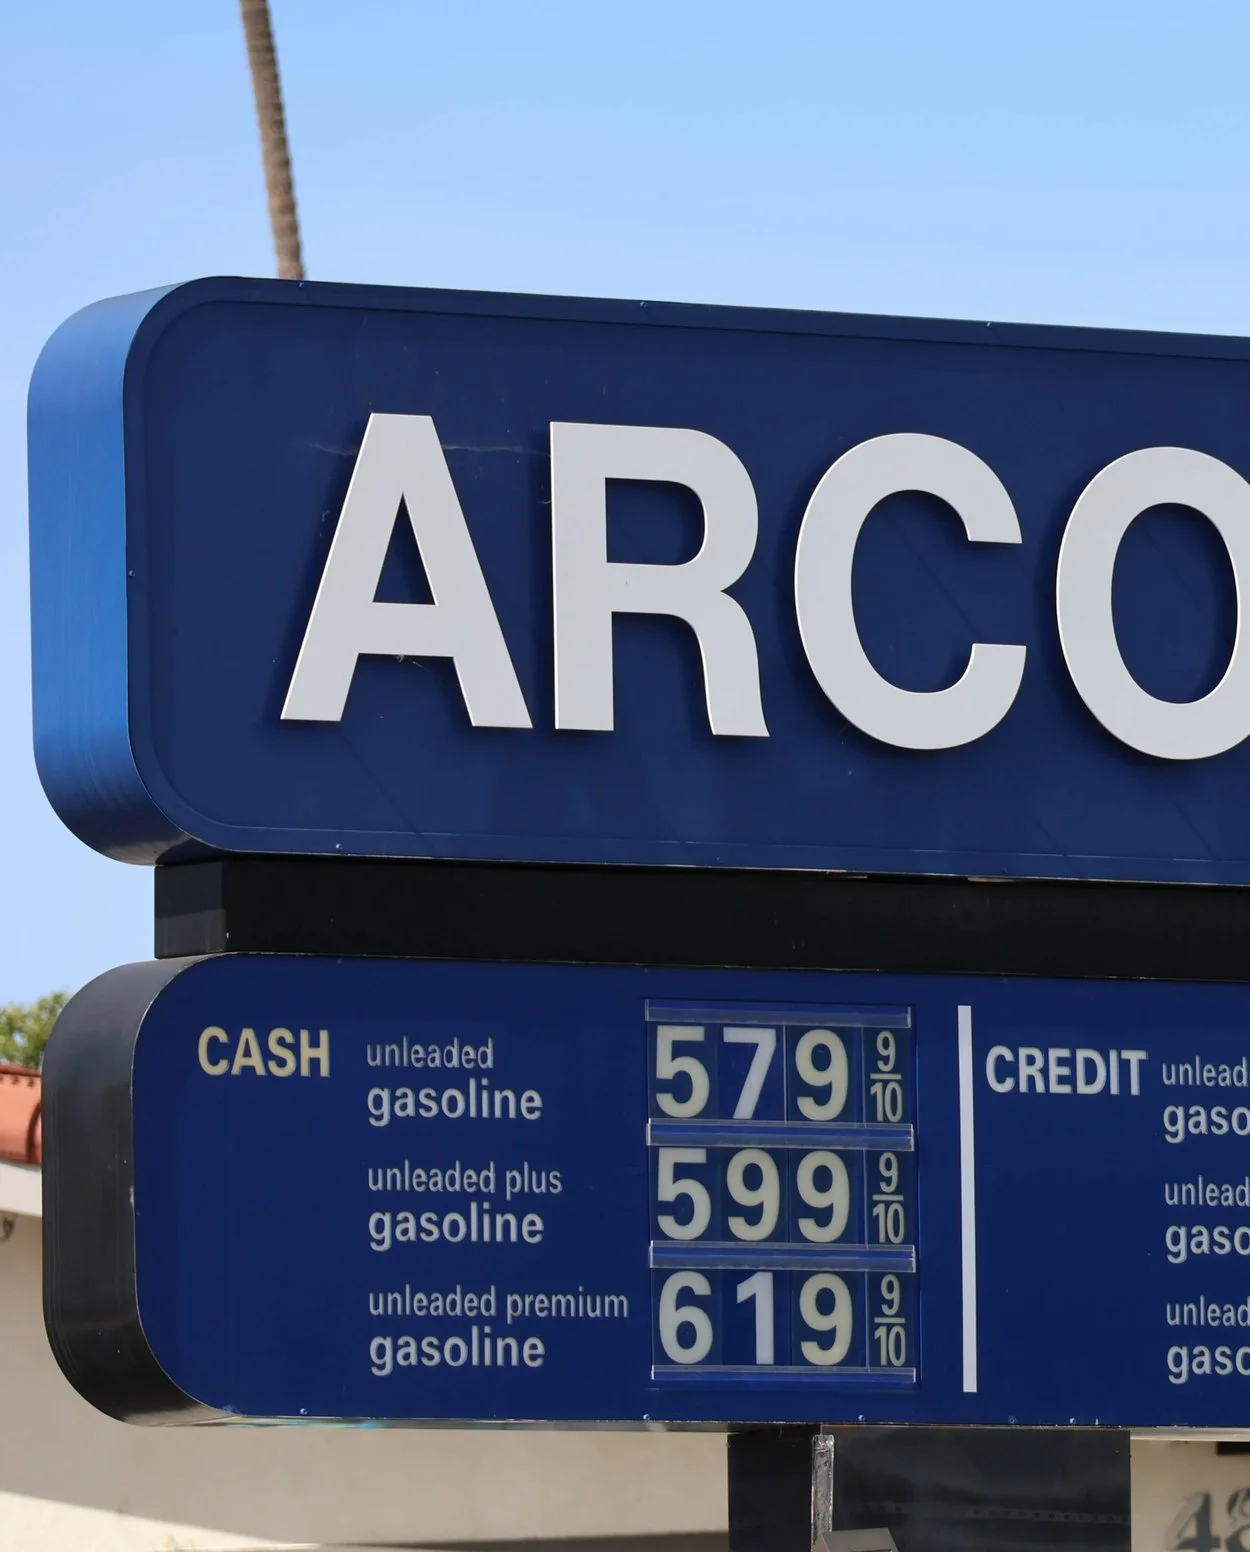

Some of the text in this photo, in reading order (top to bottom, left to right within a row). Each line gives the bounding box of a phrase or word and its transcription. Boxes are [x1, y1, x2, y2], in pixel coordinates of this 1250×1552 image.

[198, 1027, 329, 1077] CASH
[368, 1038, 493, 1068] unleaded
[877, 1032, 895, 1071] 9
[986, 1046, 1146, 1095] CREDIT
[657, 1026, 847, 1119] 579
[368, 1078, 541, 1126] gasoline
[871, 1082, 902, 1122] 10
[369, 1160, 561, 1200] unleaded plus
[880, 1153, 897, 1192] 9
[658, 1149, 849, 1242] 599
[369, 1202, 543, 1251] gasoline
[873, 1203, 904, 1243] 10
[370, 1285, 627, 1324] unleaded premium
[881, 1275, 899, 1315] 9
[660, 1272, 851, 1365] 619
[370, 1326, 544, 1375] gasoline
[875, 1326, 905, 1366] 10
